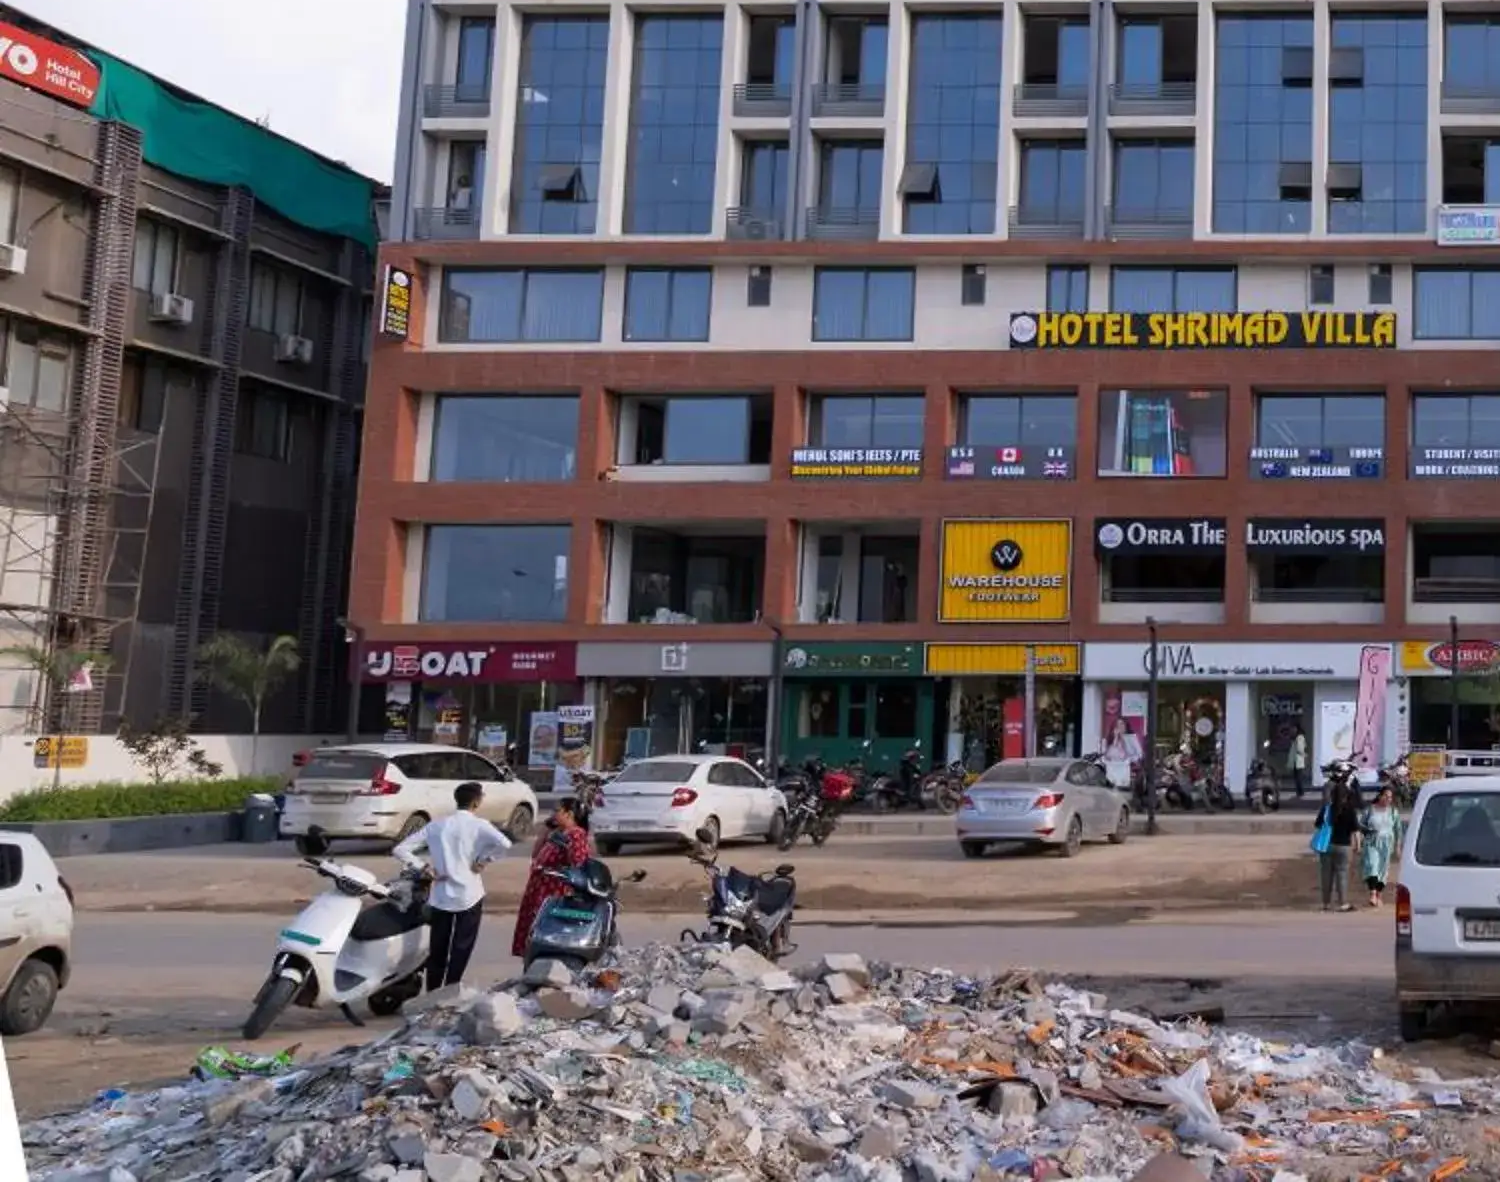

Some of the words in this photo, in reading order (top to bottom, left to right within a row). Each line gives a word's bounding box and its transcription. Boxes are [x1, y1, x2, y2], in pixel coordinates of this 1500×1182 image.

[47, 58, 80, 80] Hotel
[45, 70, 67, 87] Hill
[68, 79, 94, 99] City
[1038, 312, 1140, 347] HOTEL
[1149, 311, 1289, 348] SHRIMAD
[1301, 311, 1395, 347] VILLA
[866, 449, 892, 461] IELTS
[901, 449, 920, 461] PTE
[1251, 448, 1299, 459] AUSTRALIA
[949, 575, 1063, 588] WAREHOUSE
[968, 592, 1041, 602] FOOTWEAR
